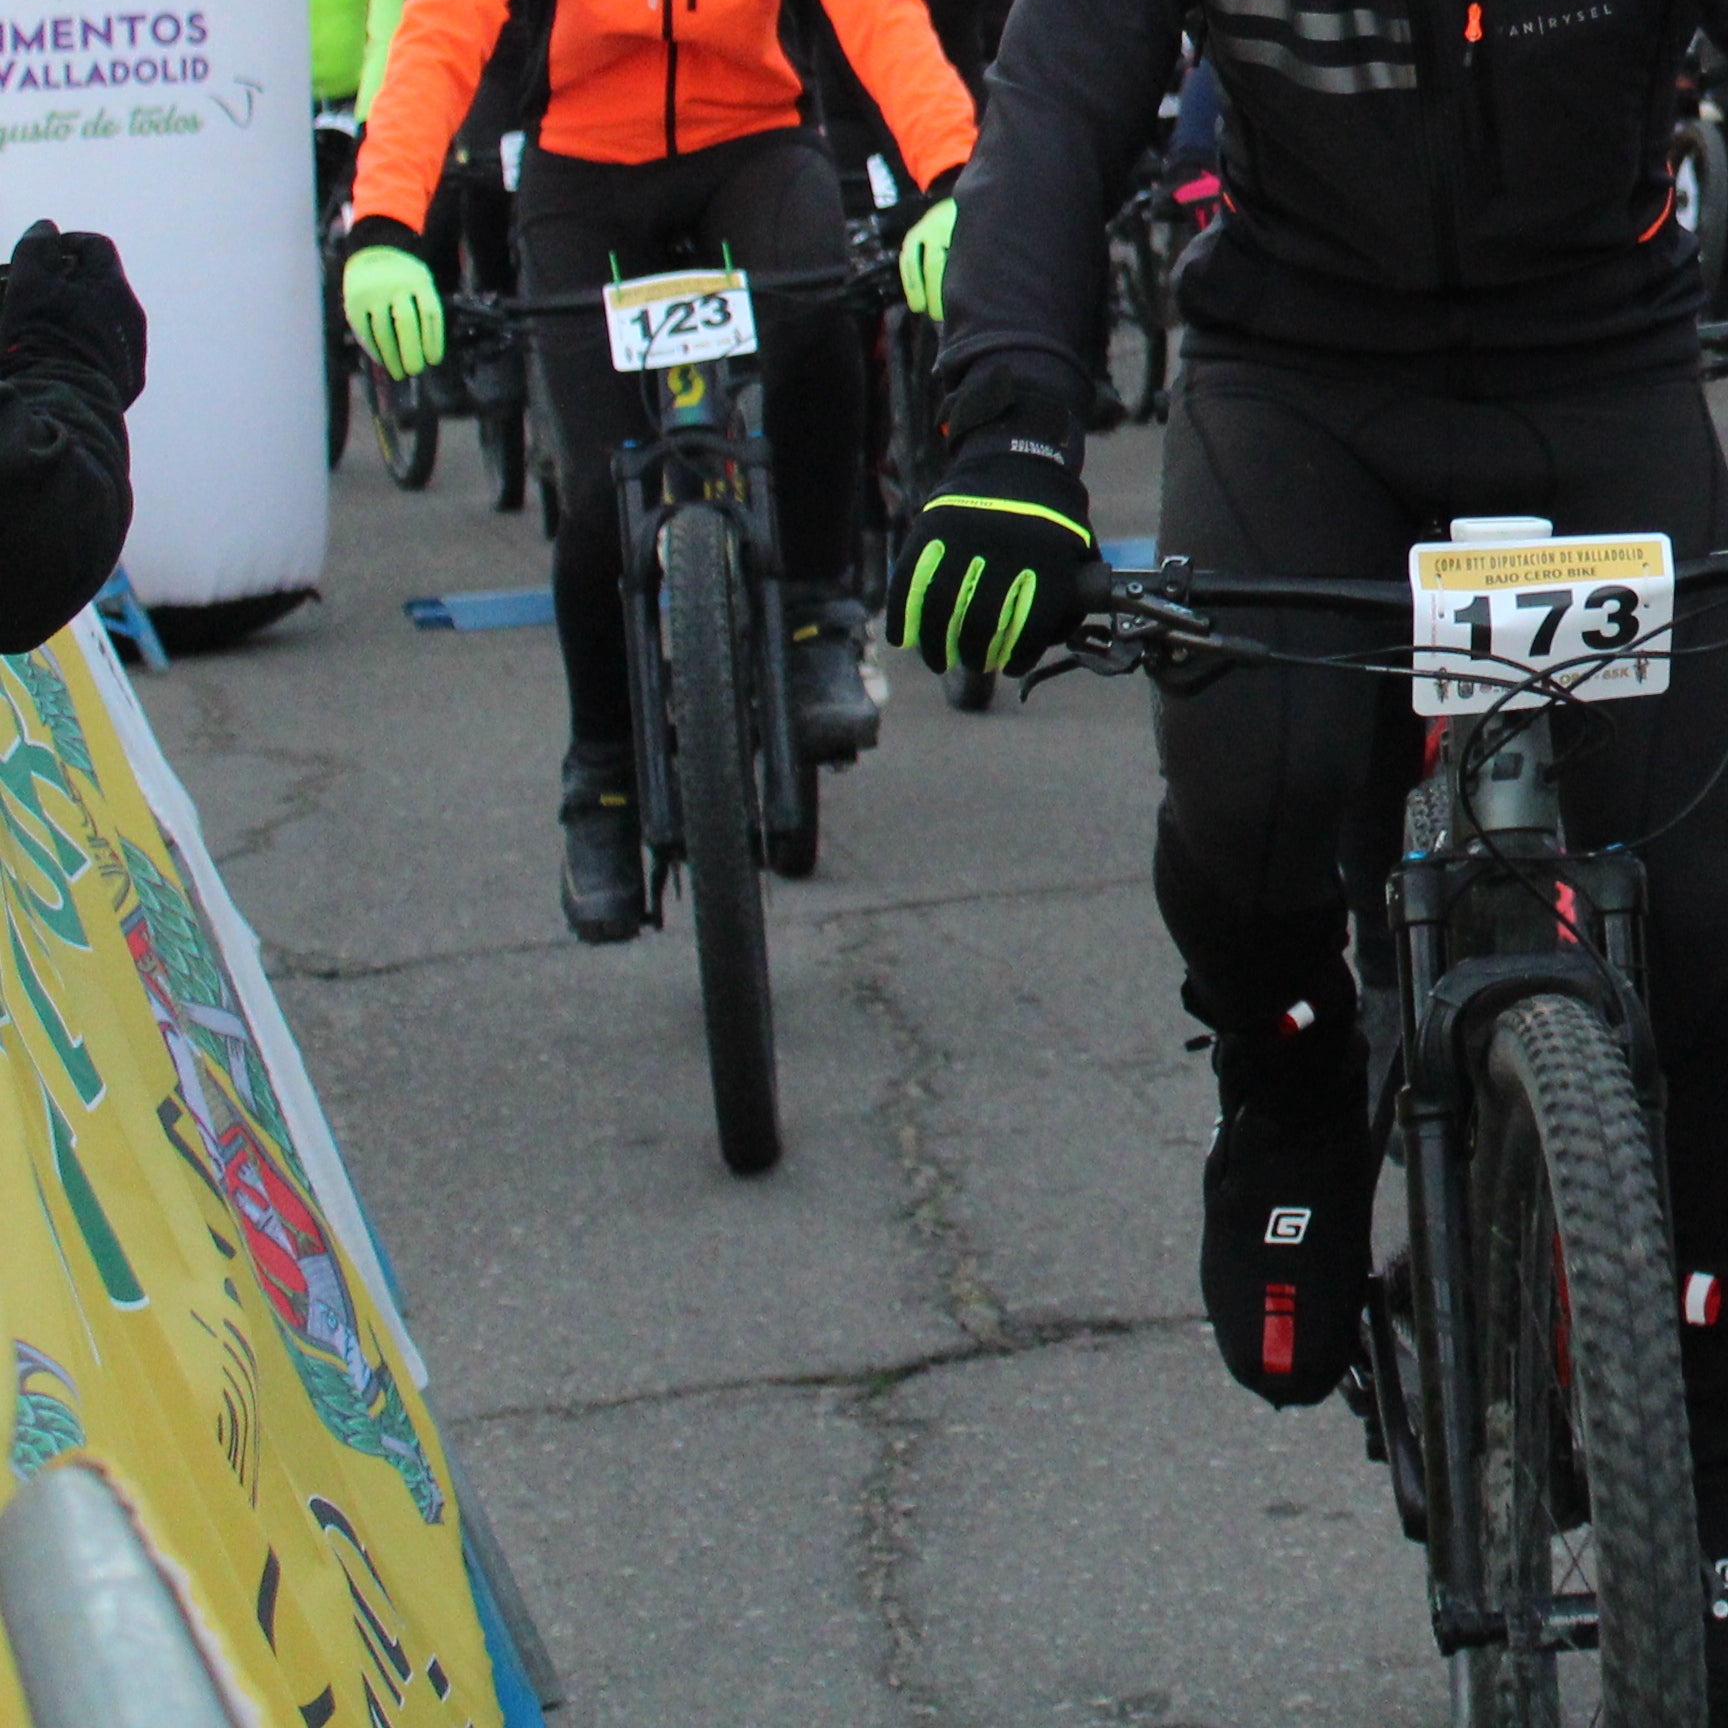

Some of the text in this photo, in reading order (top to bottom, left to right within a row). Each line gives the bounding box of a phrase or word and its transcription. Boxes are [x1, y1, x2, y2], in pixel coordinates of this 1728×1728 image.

[629, 292, 733, 341] 123
[1434, 546, 1645, 573] COPA BTT DIPUTACIÓN DE VALLADOLID
[1484, 565, 1599, 587] BAJO CERO BIKE
[1453, 584, 1640, 663] 173
